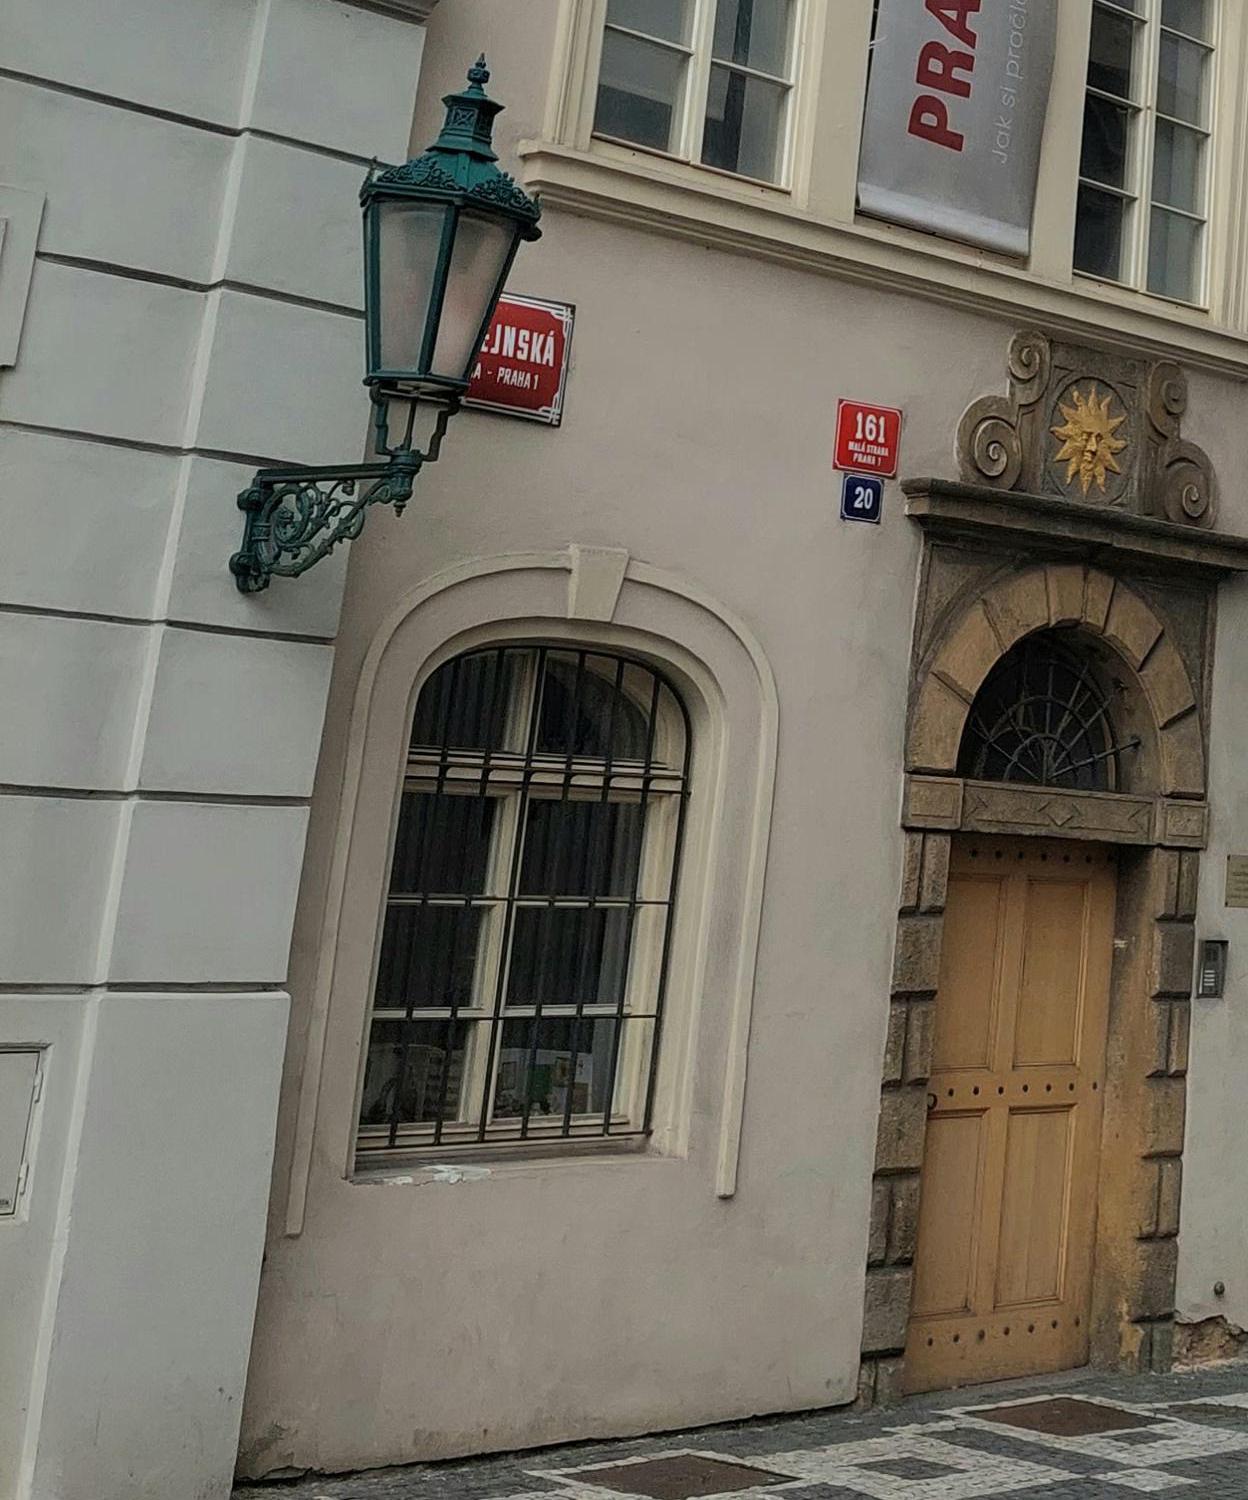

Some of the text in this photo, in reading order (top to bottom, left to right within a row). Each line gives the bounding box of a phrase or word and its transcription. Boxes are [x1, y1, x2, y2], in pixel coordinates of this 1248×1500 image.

[1000, 84, 1016, 108] si
[991, 115, 1013, 164] Jak
[497, 366, 531, 390] PRAHA
[533, 374, 539, 390] 1
[855, 411, 885, 444] 161
[853, 452, 876, 466] PRAHA
[853, 486, 874, 510] 20
